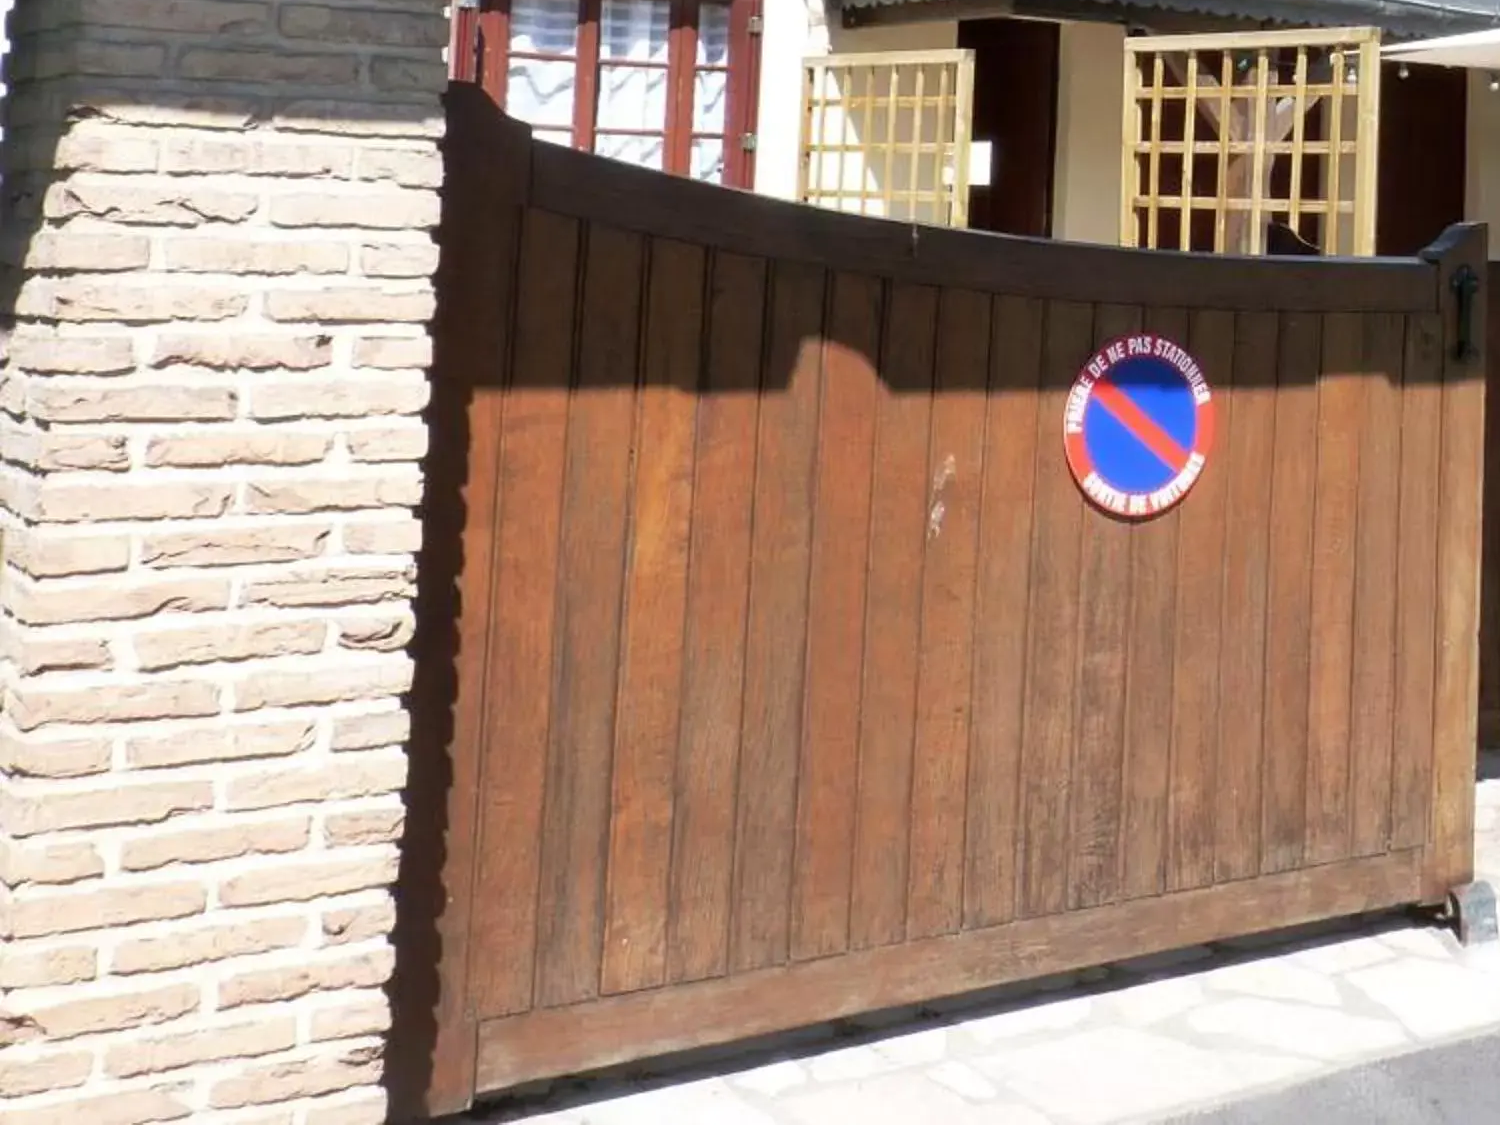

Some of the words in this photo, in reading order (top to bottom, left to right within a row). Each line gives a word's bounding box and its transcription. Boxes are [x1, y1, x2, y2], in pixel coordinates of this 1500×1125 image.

[1089, 357, 1109, 378] DE
[1106, 342, 1126, 365] NE
[1127, 336, 1151, 355] PAS
